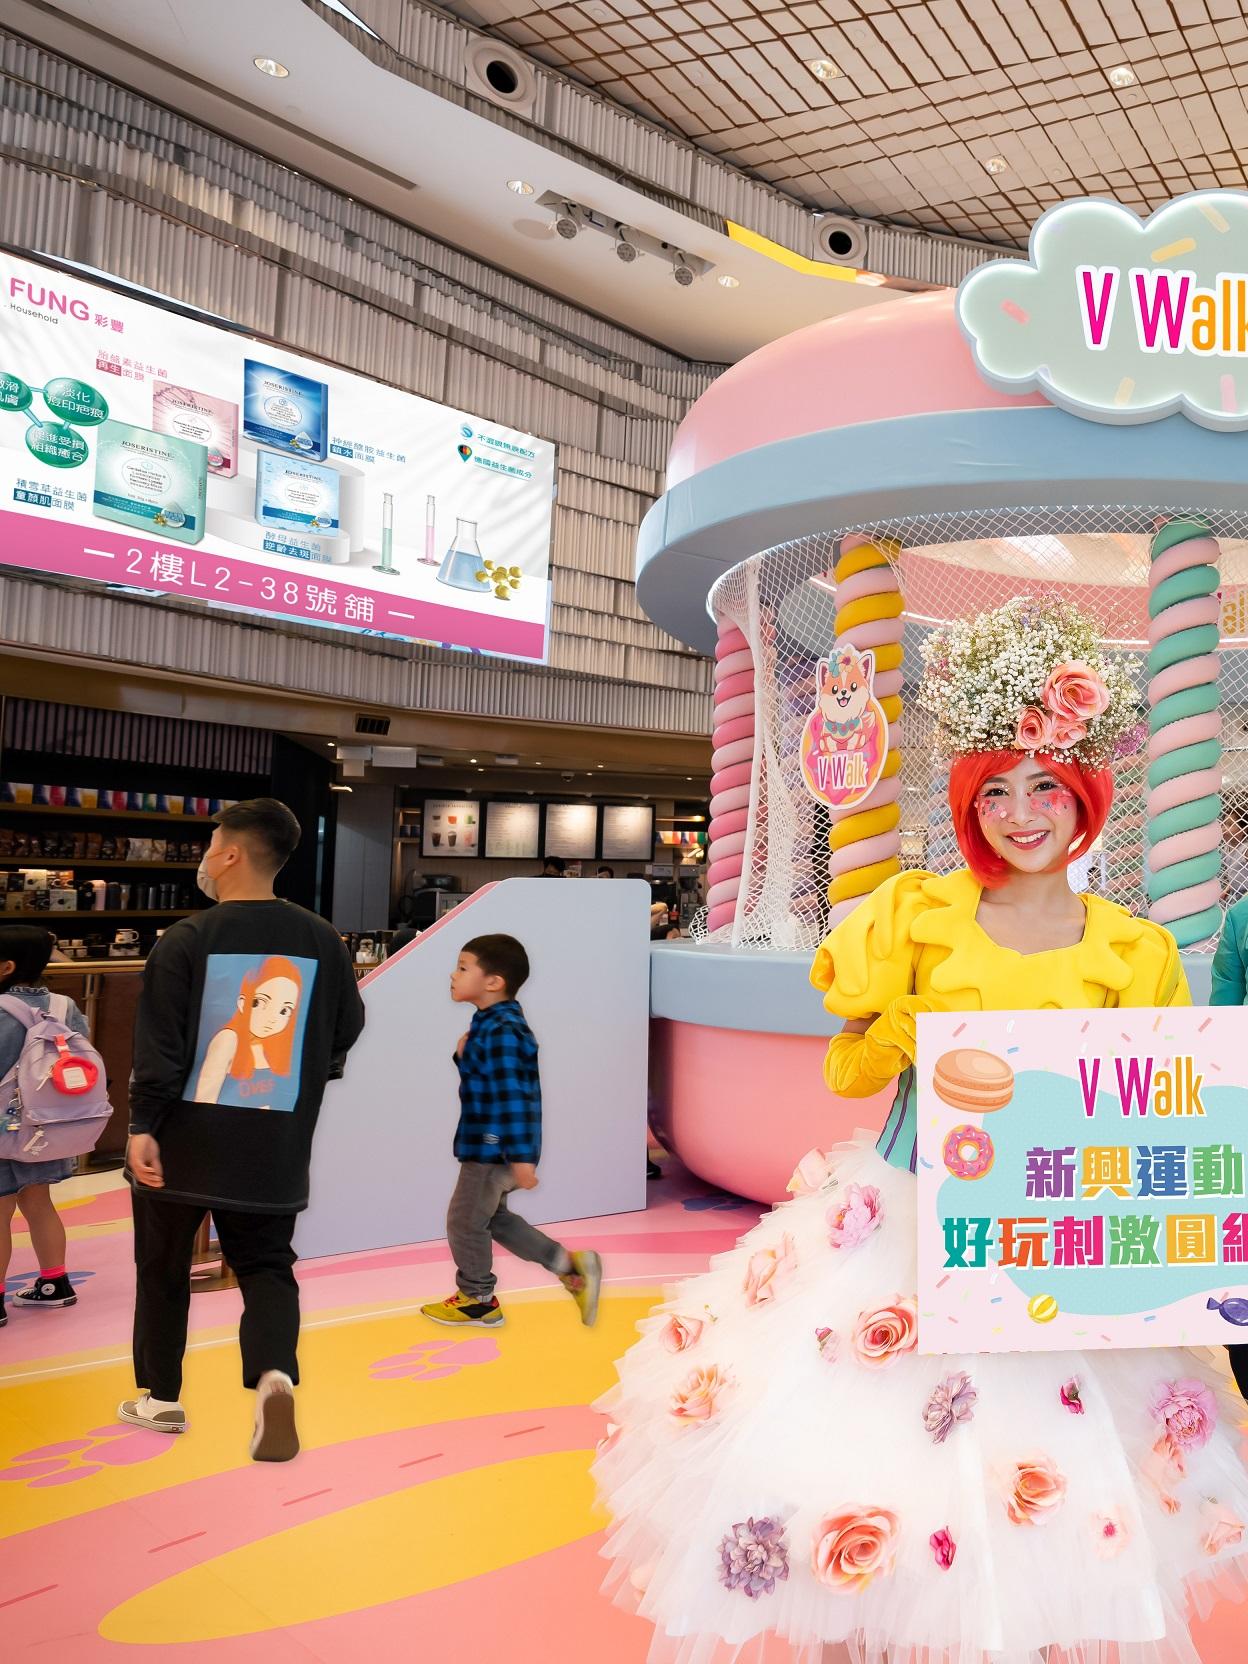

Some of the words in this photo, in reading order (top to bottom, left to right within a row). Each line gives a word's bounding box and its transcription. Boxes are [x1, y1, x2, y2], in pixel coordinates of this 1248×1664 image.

[10, 277, 89, 321] FUNG
[95, 313, 124, 333] 彩豐
[10, 304, 58, 324] Household
[1082, 271, 1113, 345] V
[63, 386, 91, 403] 淡化
[121, 440, 172, 458] JOSERISTINE
[818, 757, 828, 790] V
[833, 753, 867, 789] Walk
[1078, 1058, 1101, 1117] V
[1114, 1056, 1204, 1117] Walk
[1025, 1145, 1245, 1199] 新興運動
